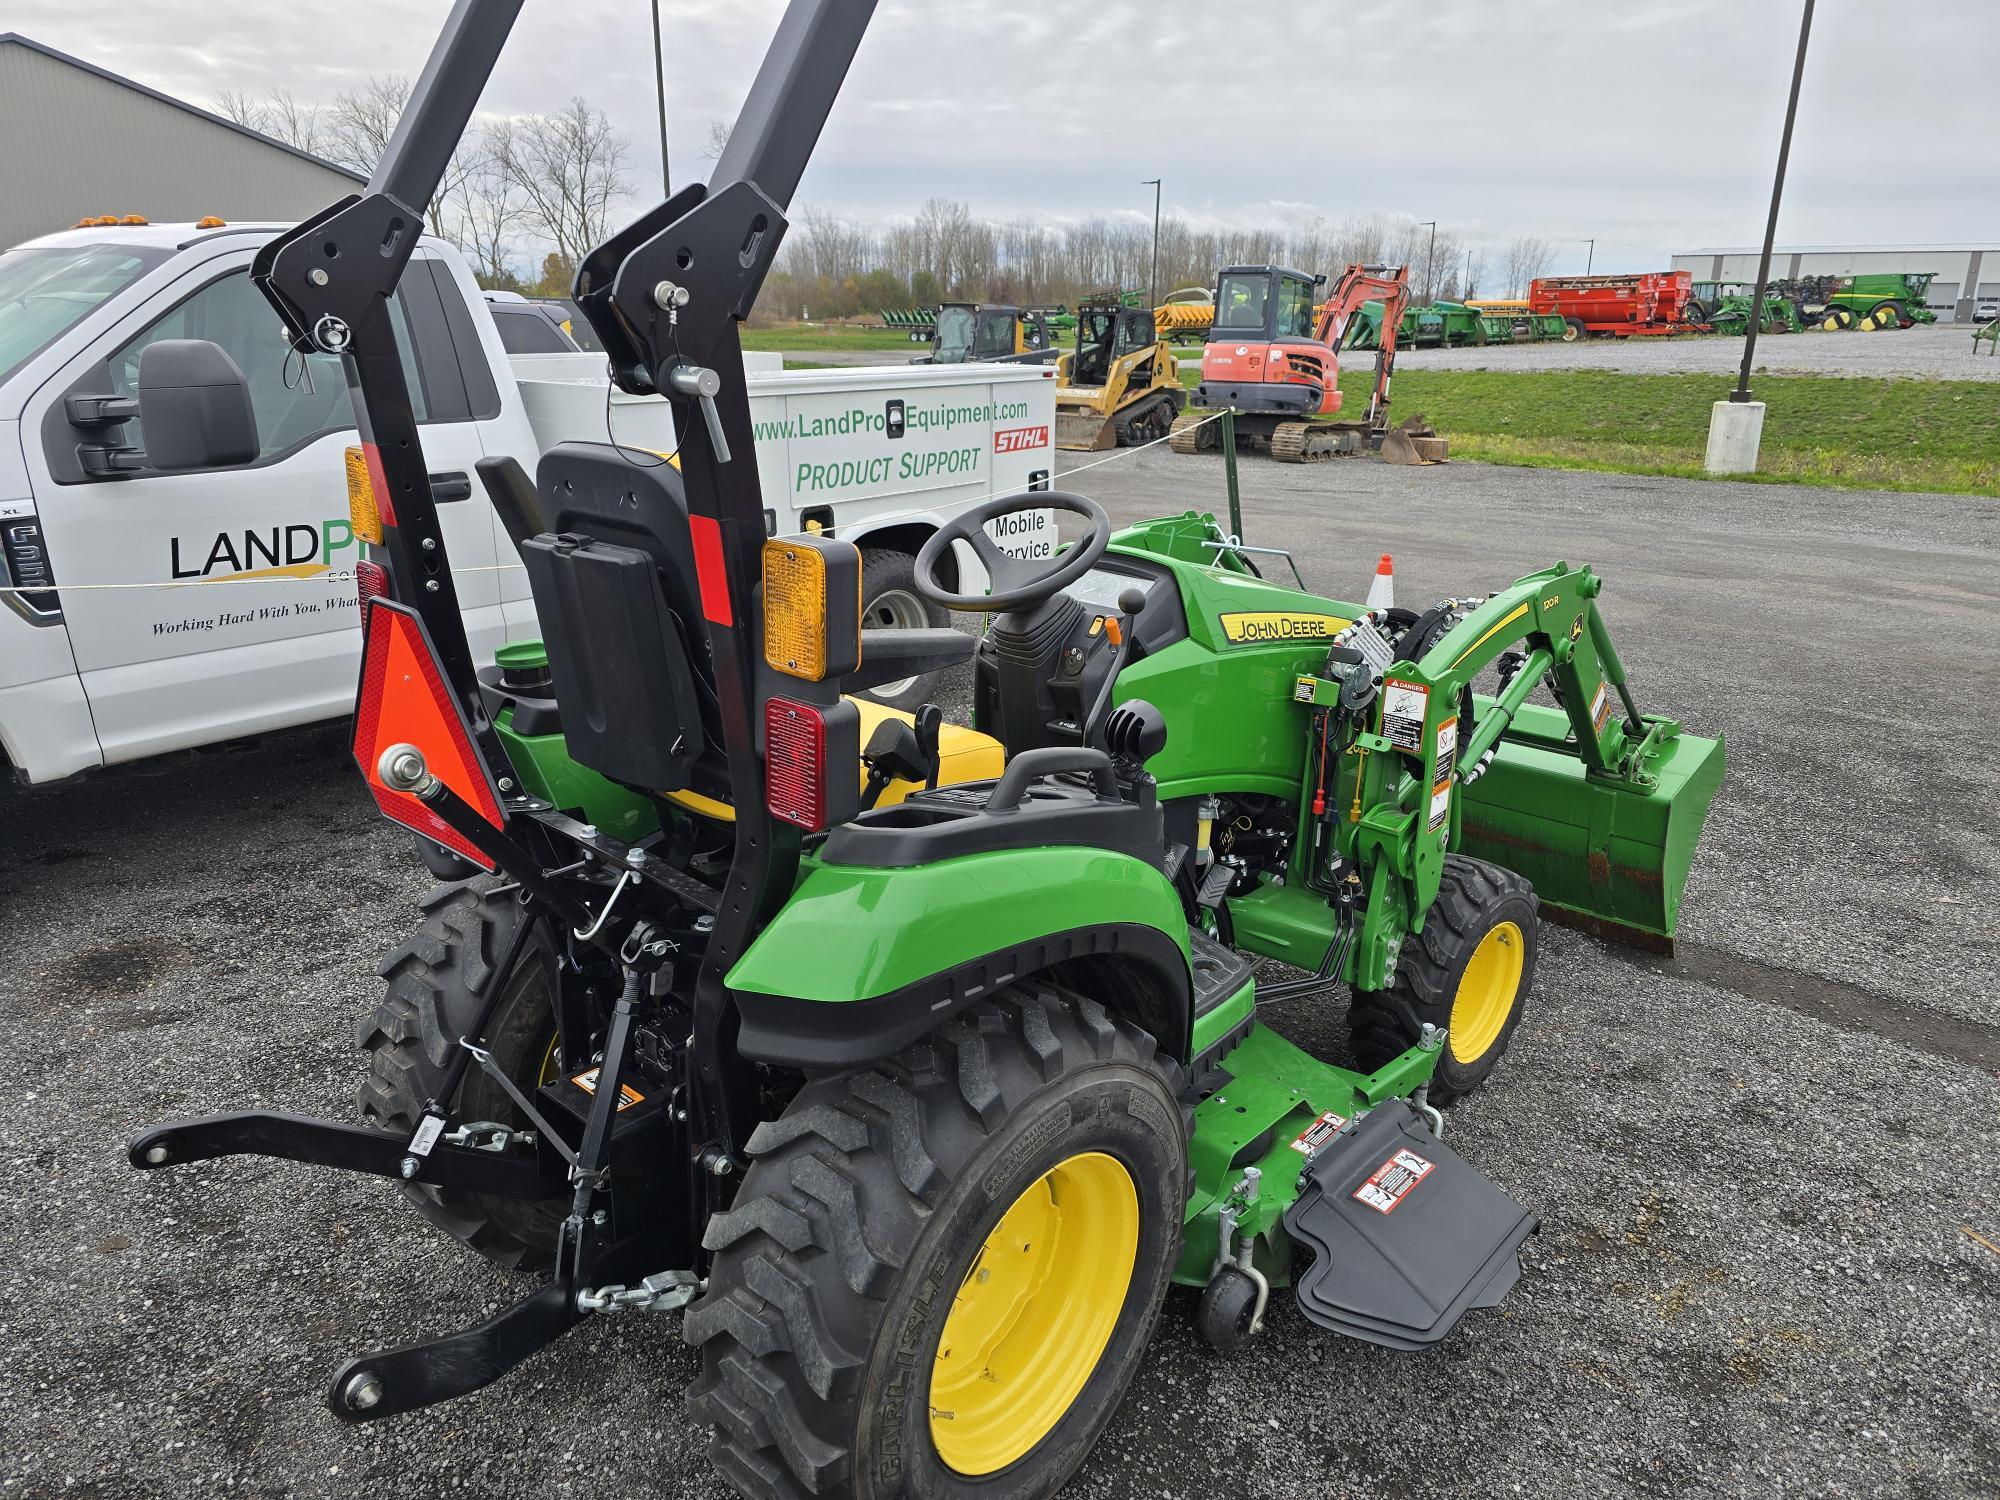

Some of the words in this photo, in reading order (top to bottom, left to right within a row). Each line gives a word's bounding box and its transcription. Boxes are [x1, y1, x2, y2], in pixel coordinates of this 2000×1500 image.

[996, 428, 1046, 452] STIHL
[796, 457, 893, 492] PRODUCT
[899, 448, 981, 479] SUPPORT
[996, 512, 1045, 537] Mobile
[171, 519, 366, 579] LANDP
[153, 617, 214, 636] Working
[219, 610, 255, 626] Hard
[259, 605, 289, 620] With
[294, 602, 321, 615] You,
[1238, 620, 1279, 640] JOHN
[1280, 618, 1327, 636] DEERE
[1399, 682, 1425, 693] DANGER
[880, 1252, 952, 1485] CARLISLE
